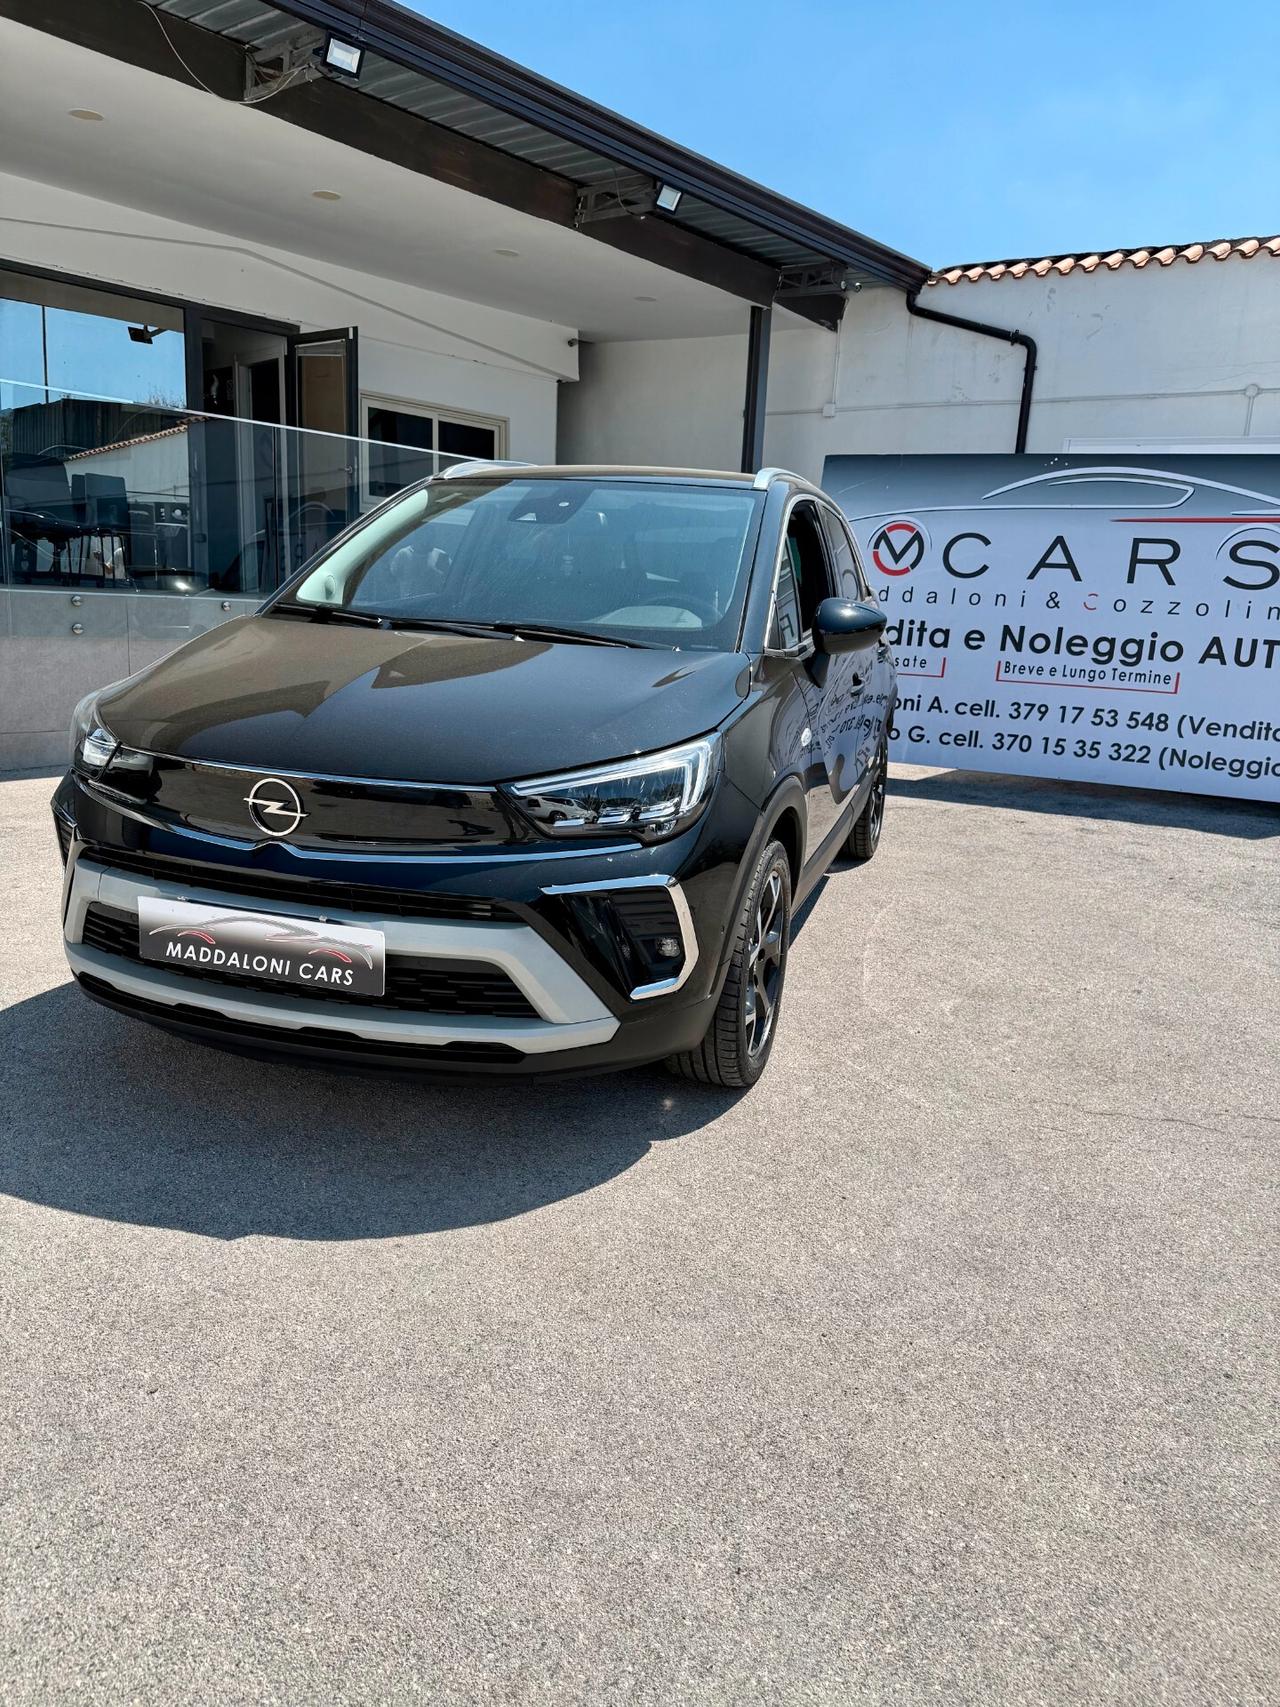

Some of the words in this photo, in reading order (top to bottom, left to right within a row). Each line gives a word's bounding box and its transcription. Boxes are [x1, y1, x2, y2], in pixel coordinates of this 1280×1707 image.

[943, 532, 1280, 590] CARS
[879, 586, 1026, 607] ddaloni
[1046, 591, 1060, 609] &
[964, 630, 985, 650] e
[1000, 625, 1184, 667] Noleggio
[1198, 636, 1280, 669] AUT
[1004, 661, 1043, 676] Breve
[1049, 669, 1057, 677] e
[1062, 665, 1106, 682] Lungo
[1112, 668, 1172, 684] Termine
[928, 696, 949, 714] A.
[955, 700, 1000, 718] cell.
[1009, 702, 1049, 721] 379
[1059, 706, 1084, 724] 17
[1091, 708, 1119, 727] 53
[1126, 711, 1169, 732] 548
[908, 726, 931, 744] G.
[939, 730, 984, 748] cell.
[992, 732, 1032, 753] 370
[1042, 737, 1066, 756] 15
[1073, 739, 1102, 758] 35
[1108, 743, 1151, 763] 322
[166, 941, 291, 976] MADDALONI
[299, 963, 353, 986] CARS
